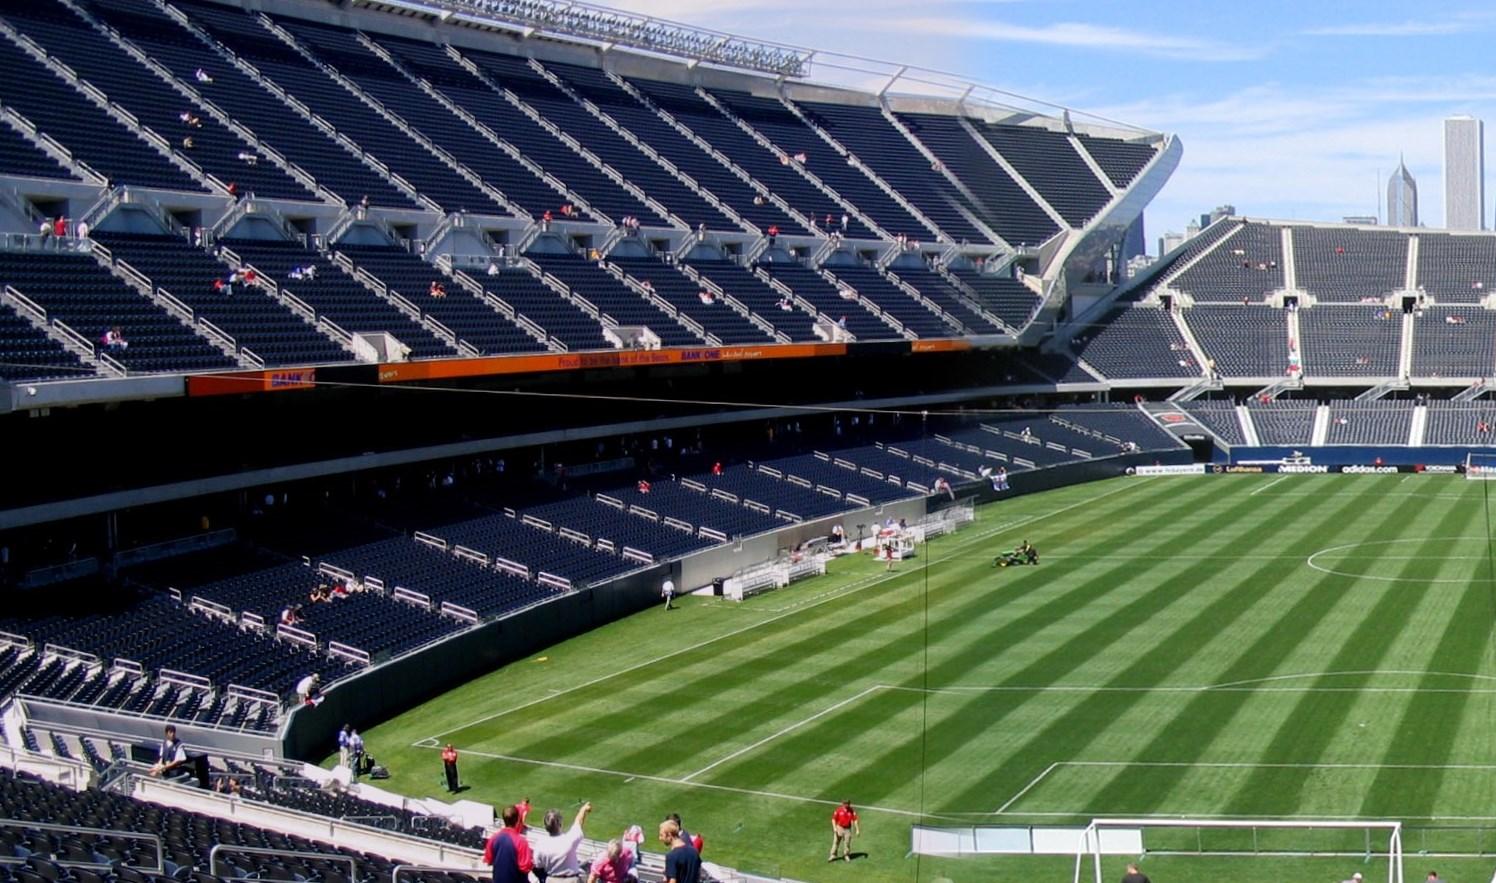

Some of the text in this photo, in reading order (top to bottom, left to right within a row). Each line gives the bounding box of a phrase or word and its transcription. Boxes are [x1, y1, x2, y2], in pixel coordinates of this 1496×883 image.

[682, 350, 720, 360] BANK ONE
[1278, 465, 1328, 473] MEDION
[1342, 464, 1398, 474] adidas.com
